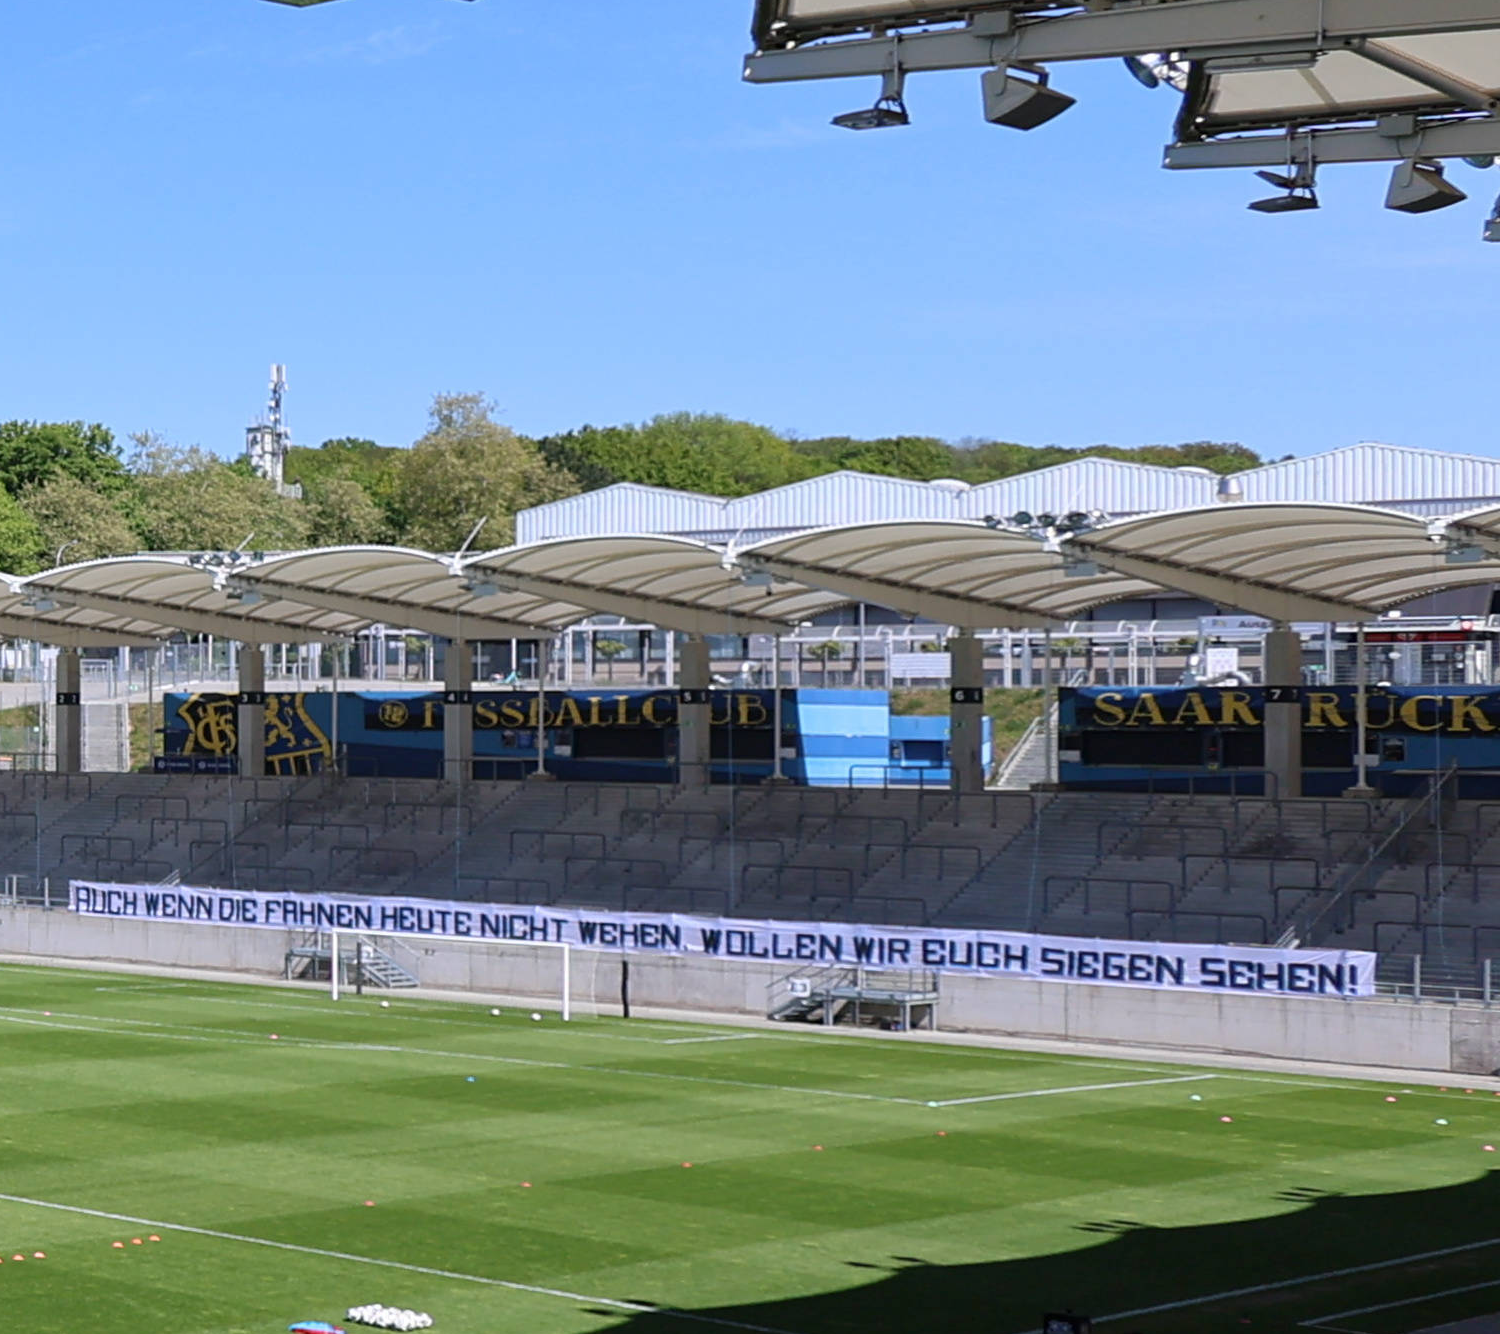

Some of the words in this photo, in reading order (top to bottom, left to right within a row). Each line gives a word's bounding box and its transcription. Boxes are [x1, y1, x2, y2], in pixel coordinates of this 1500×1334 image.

[447, 691, 457, 702] 4
[954, 690, 965, 701] 6
[1269, 688, 1283, 700] 7
[75, 885, 138, 917] AUCH
[144, 892, 213, 919] WENN
[218, 896, 257, 923] DIE
[264, 898, 372, 928] FAHNEN
[380, 906, 472, 936] HEUTE
[480, 913, 568, 942] NICHT
[700, 927, 842, 962] WOLLEN
[853, 935, 911, 965] WIR
[921, 938, 1029, 971] EUCH
[1040, 946, 1185, 986] SIEGEN
[1199, 955, 1359, 995] SEHEN!
